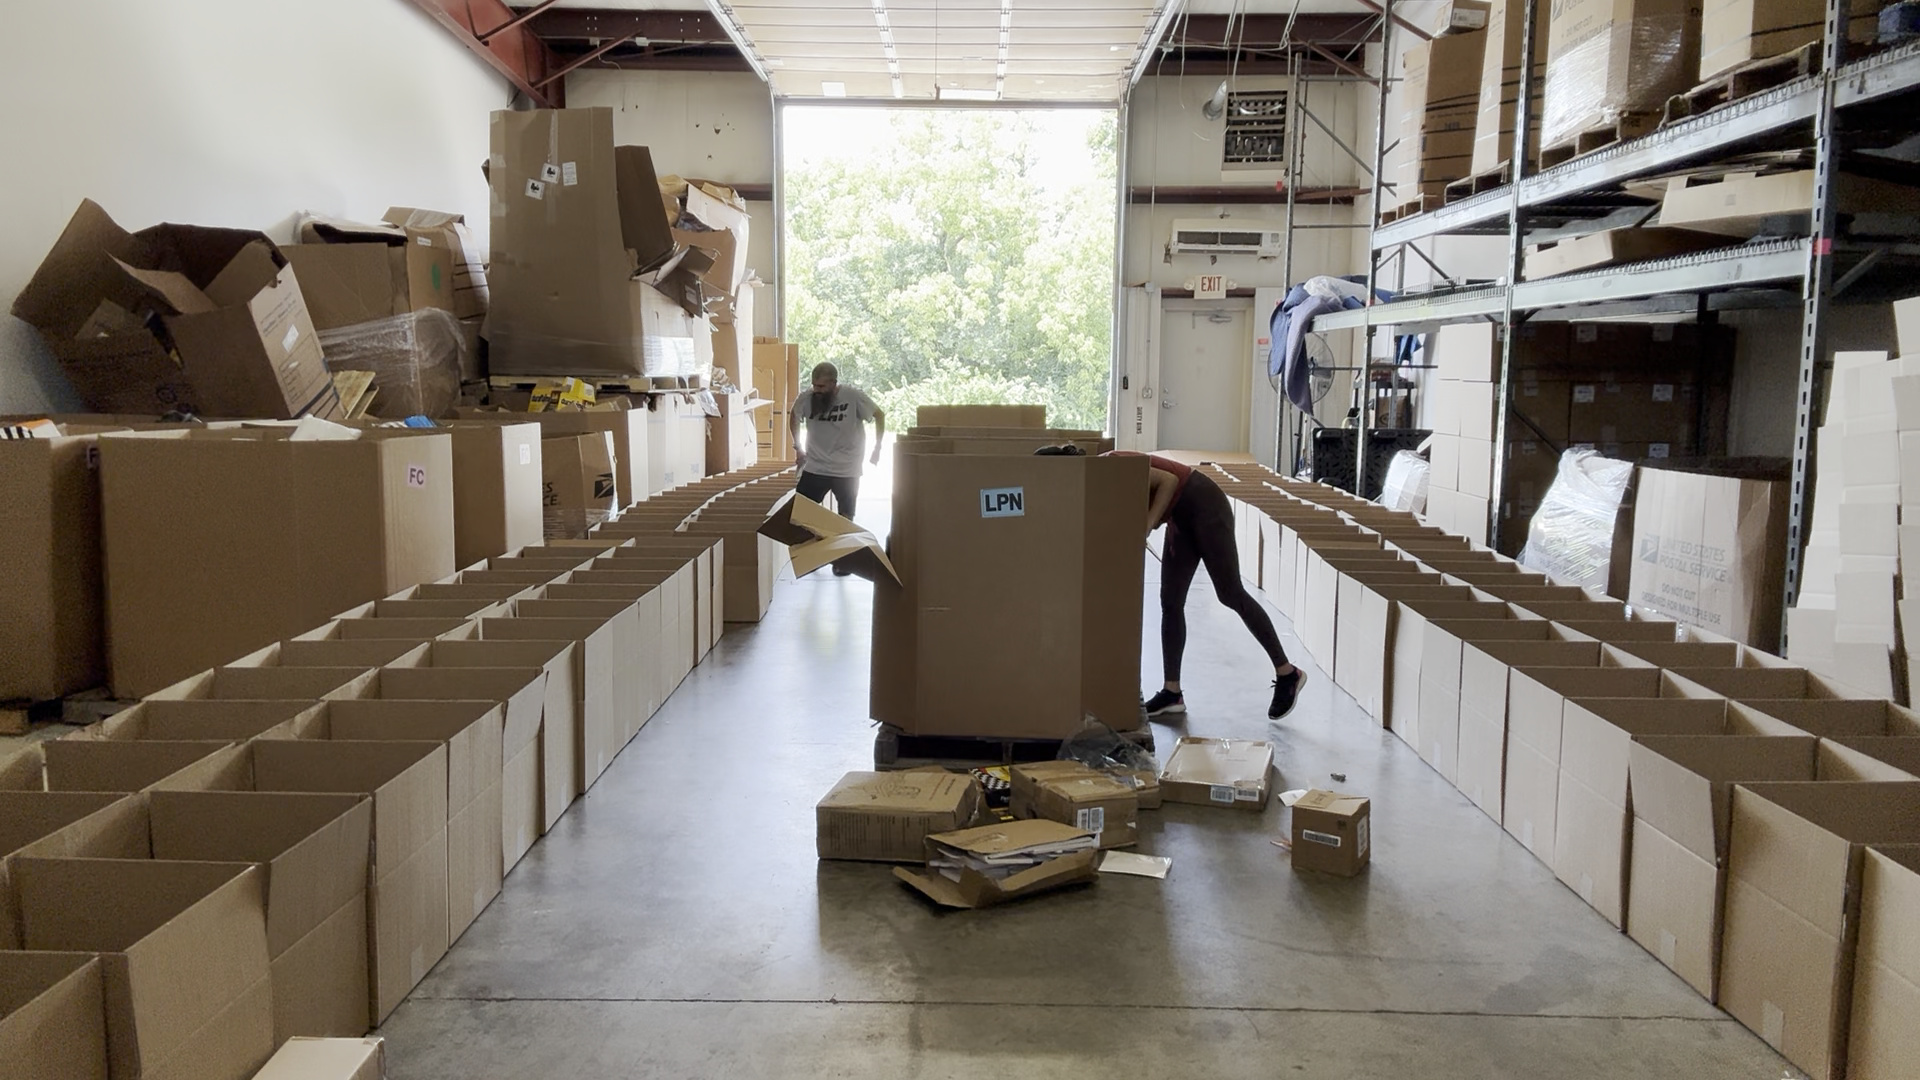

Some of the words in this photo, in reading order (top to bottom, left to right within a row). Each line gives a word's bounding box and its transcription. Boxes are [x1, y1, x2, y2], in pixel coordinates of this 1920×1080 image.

[1201, 276, 1222, 292] EXIT
[409, 467, 424, 485] FC
[985, 493, 1022, 512] LPN
[1692, 543, 1725, 562] STATES
[1659, 554, 1688, 573] POSTAL
[1688, 560, 1727, 582] SERVICE
